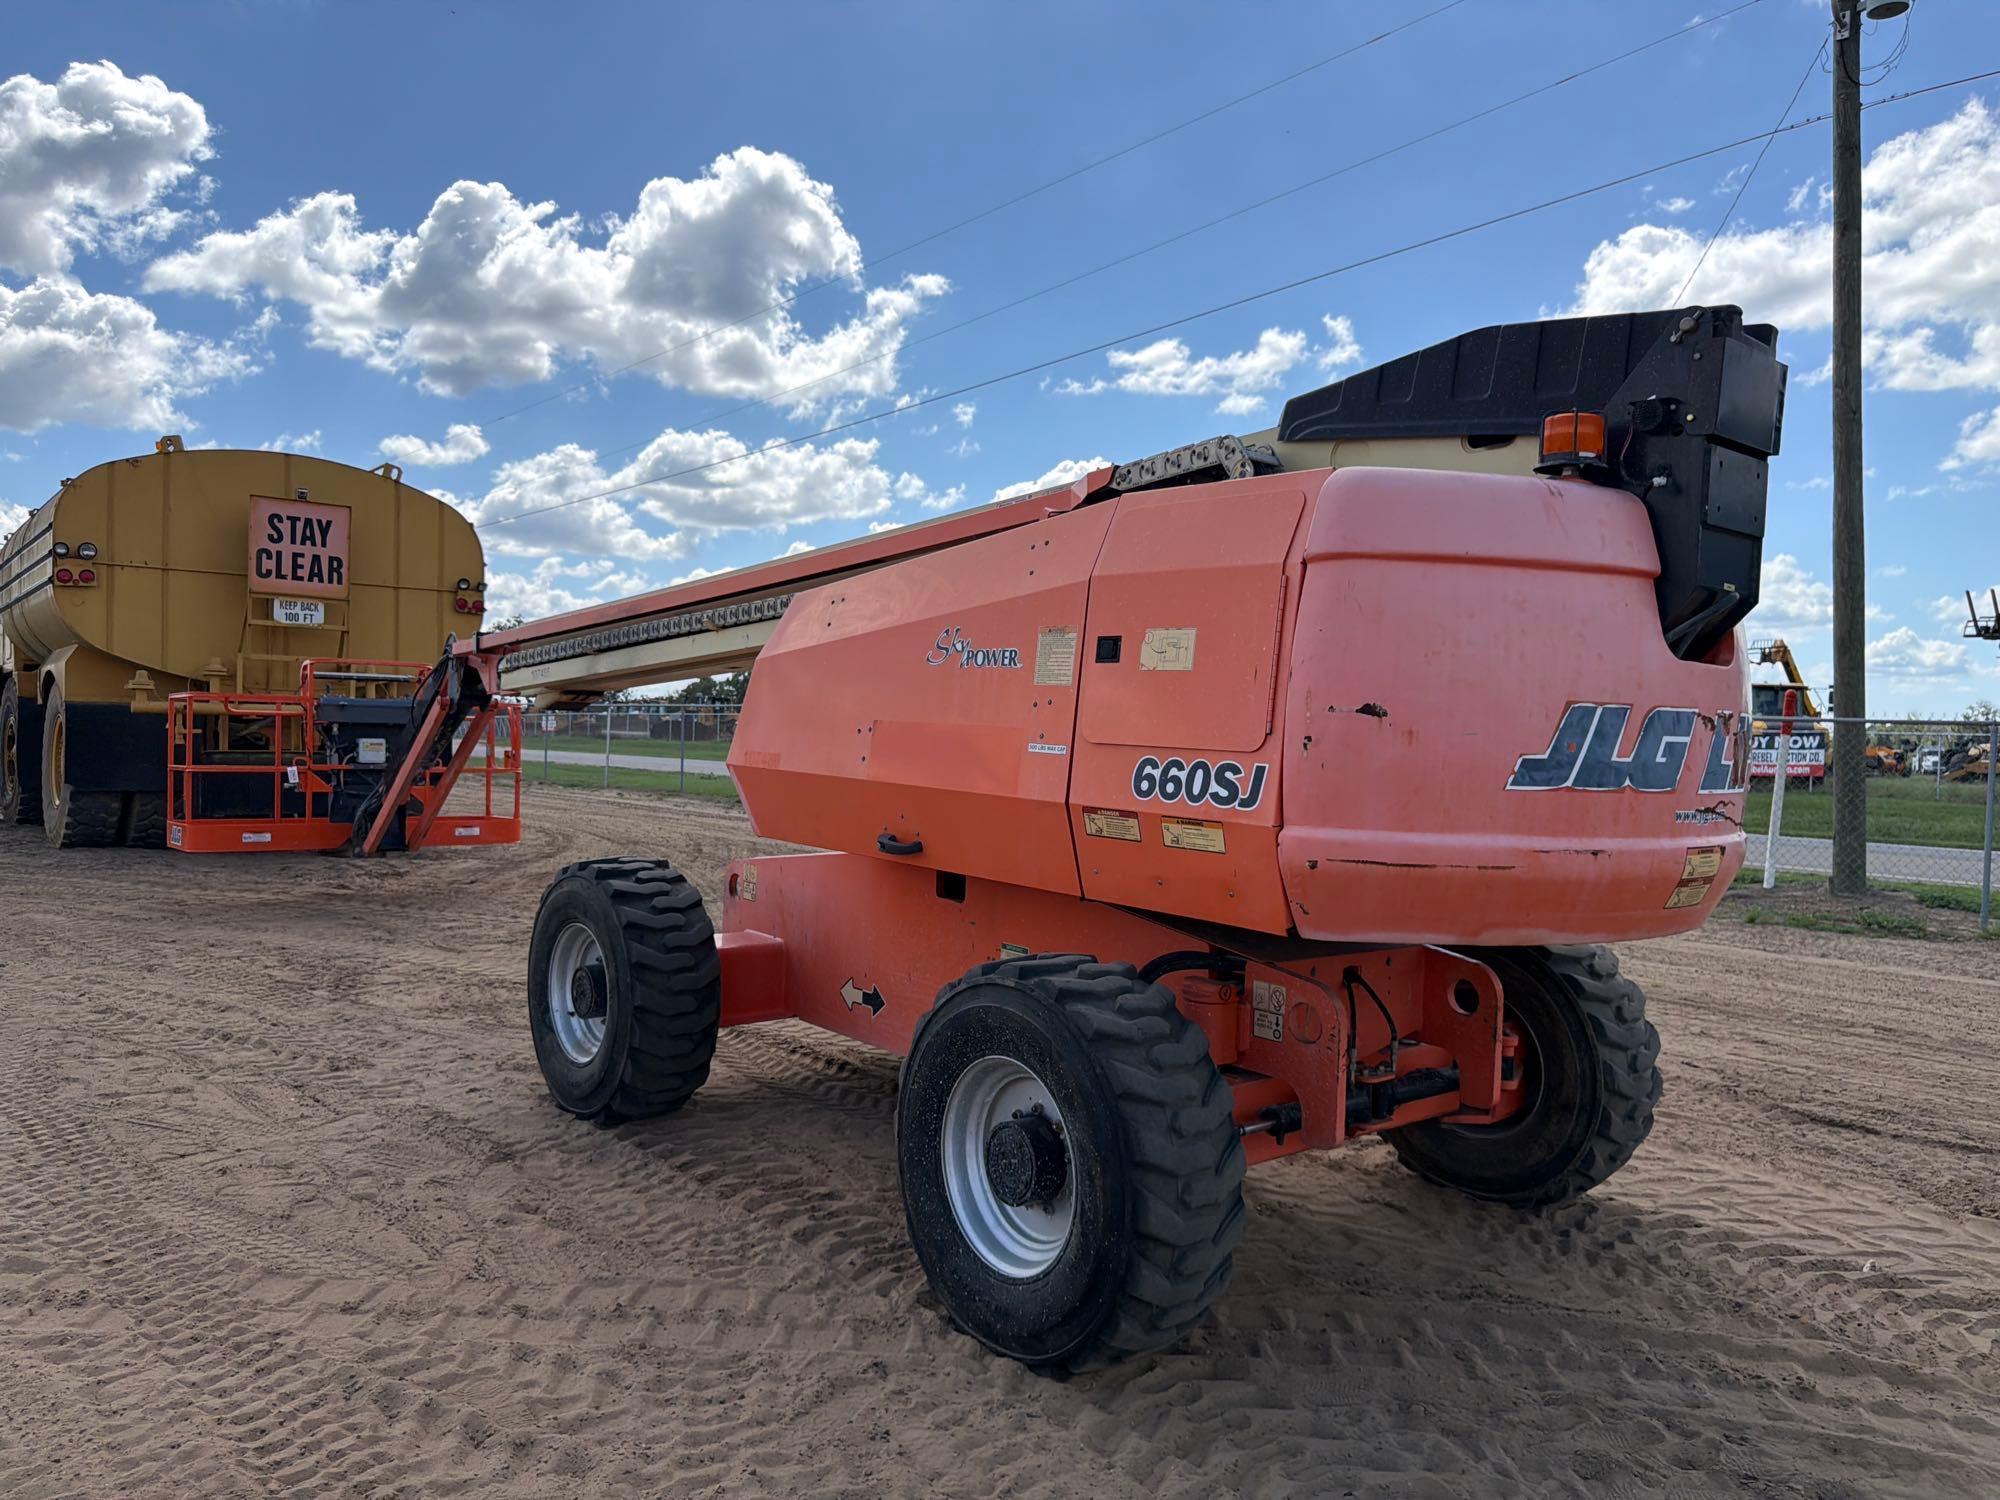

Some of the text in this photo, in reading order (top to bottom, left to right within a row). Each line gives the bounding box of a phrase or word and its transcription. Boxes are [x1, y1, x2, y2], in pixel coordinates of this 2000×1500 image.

[266, 512, 333, 548] STAY
[255, 547, 344, 586] CLEAR
[280, 600, 319, 613] KEEP BACK
[284, 611, 315, 623] 100 FT
[965, 648, 1019, 668] POWER
[1504, 701, 1700, 793] JLG
[1752, 751, 1773, 763] REBEL
[1132, 755, 1269, 811] 660SJ
